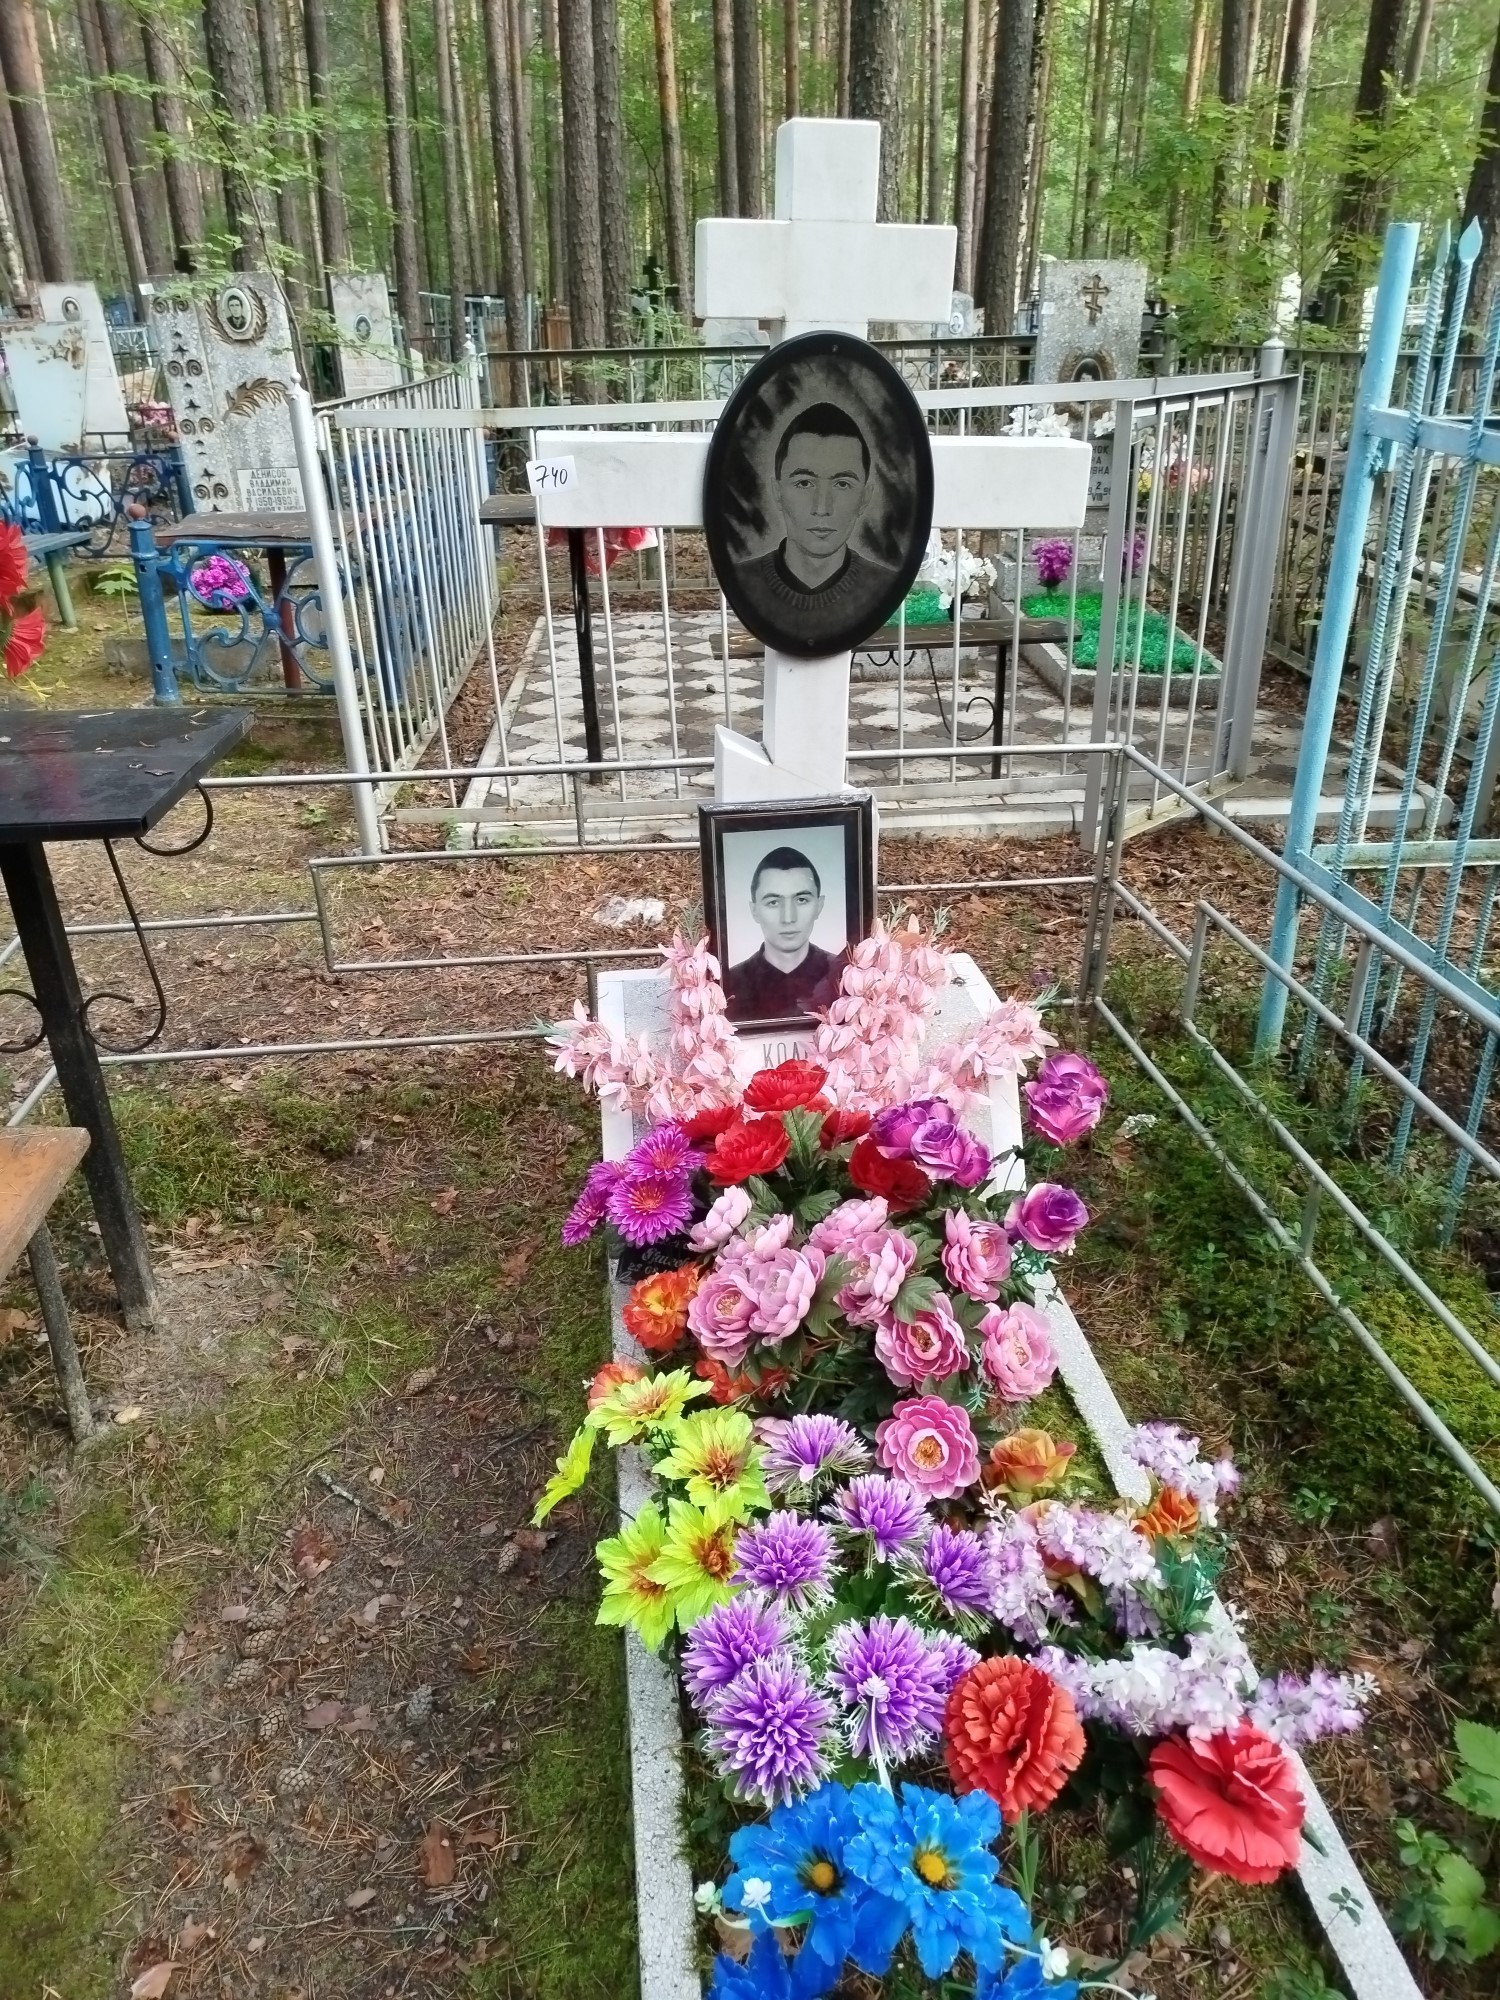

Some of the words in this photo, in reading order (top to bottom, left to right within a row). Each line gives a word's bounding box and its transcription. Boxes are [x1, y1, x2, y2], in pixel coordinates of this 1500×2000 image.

[250, 469, 287, 479] ДЕНИСОВ
[534, 465, 568, 489] 740
[249, 478, 292, 488] ВЛАДИМИР
[246, 487, 298, 497] ВАСИЛЬЕВИЧ
